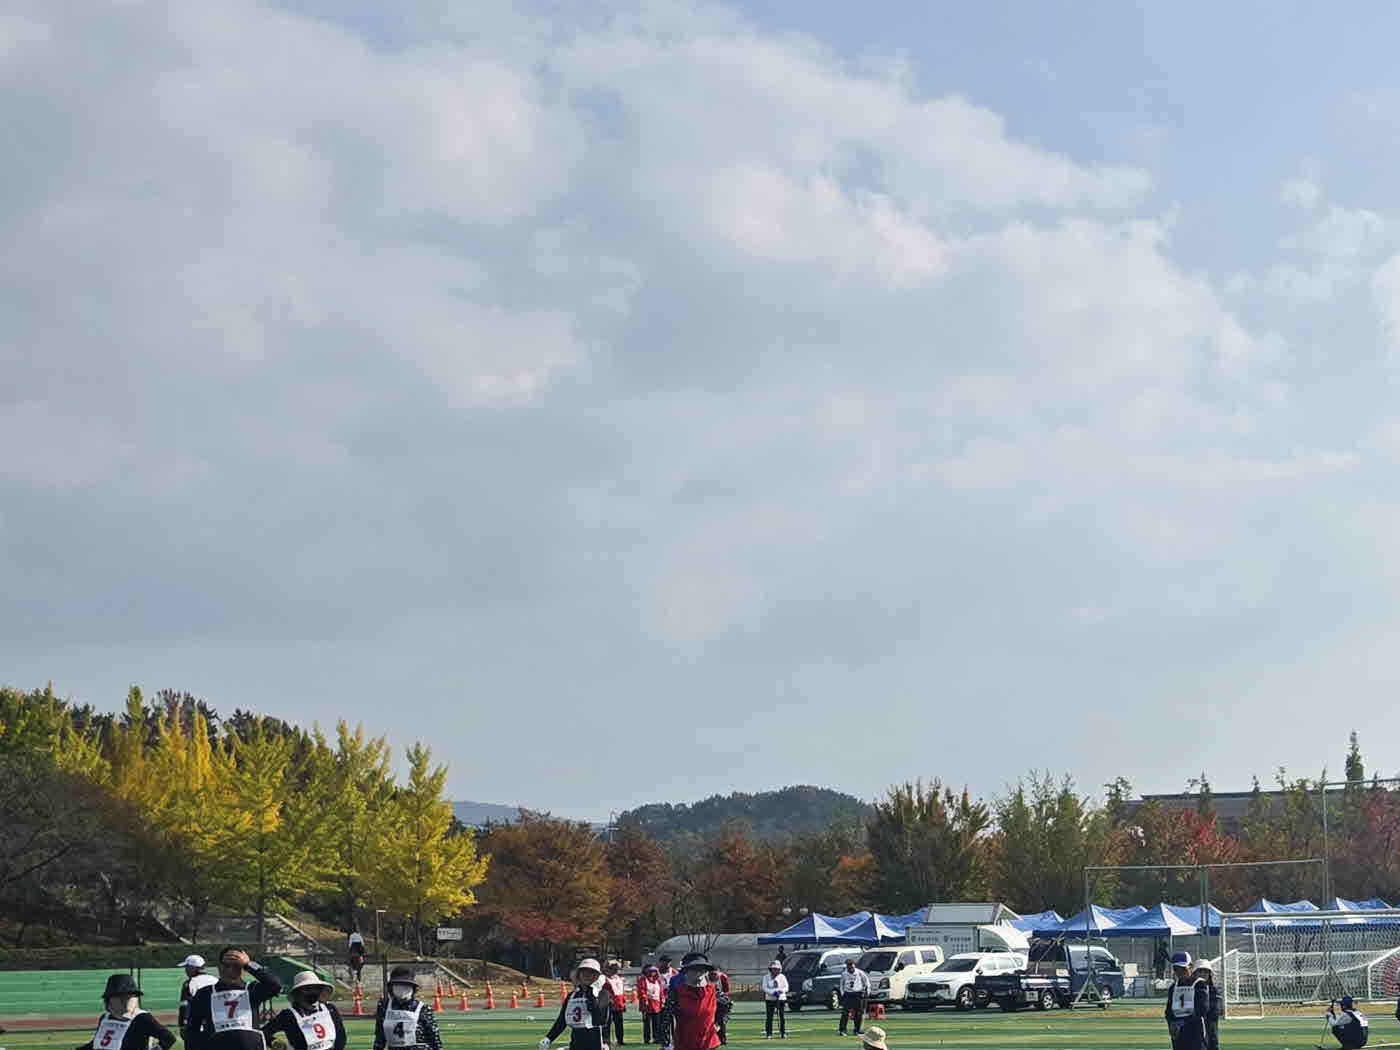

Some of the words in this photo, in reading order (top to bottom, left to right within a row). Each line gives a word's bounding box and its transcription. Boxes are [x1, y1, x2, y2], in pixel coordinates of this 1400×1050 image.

[223, 1000, 239, 1019] 7
[572, 1006, 582, 1023] 3
[100, 1030, 115, 1047] 5
[313, 1023, 326, 1040] 9
[393, 1022, 405, 1039] 4
